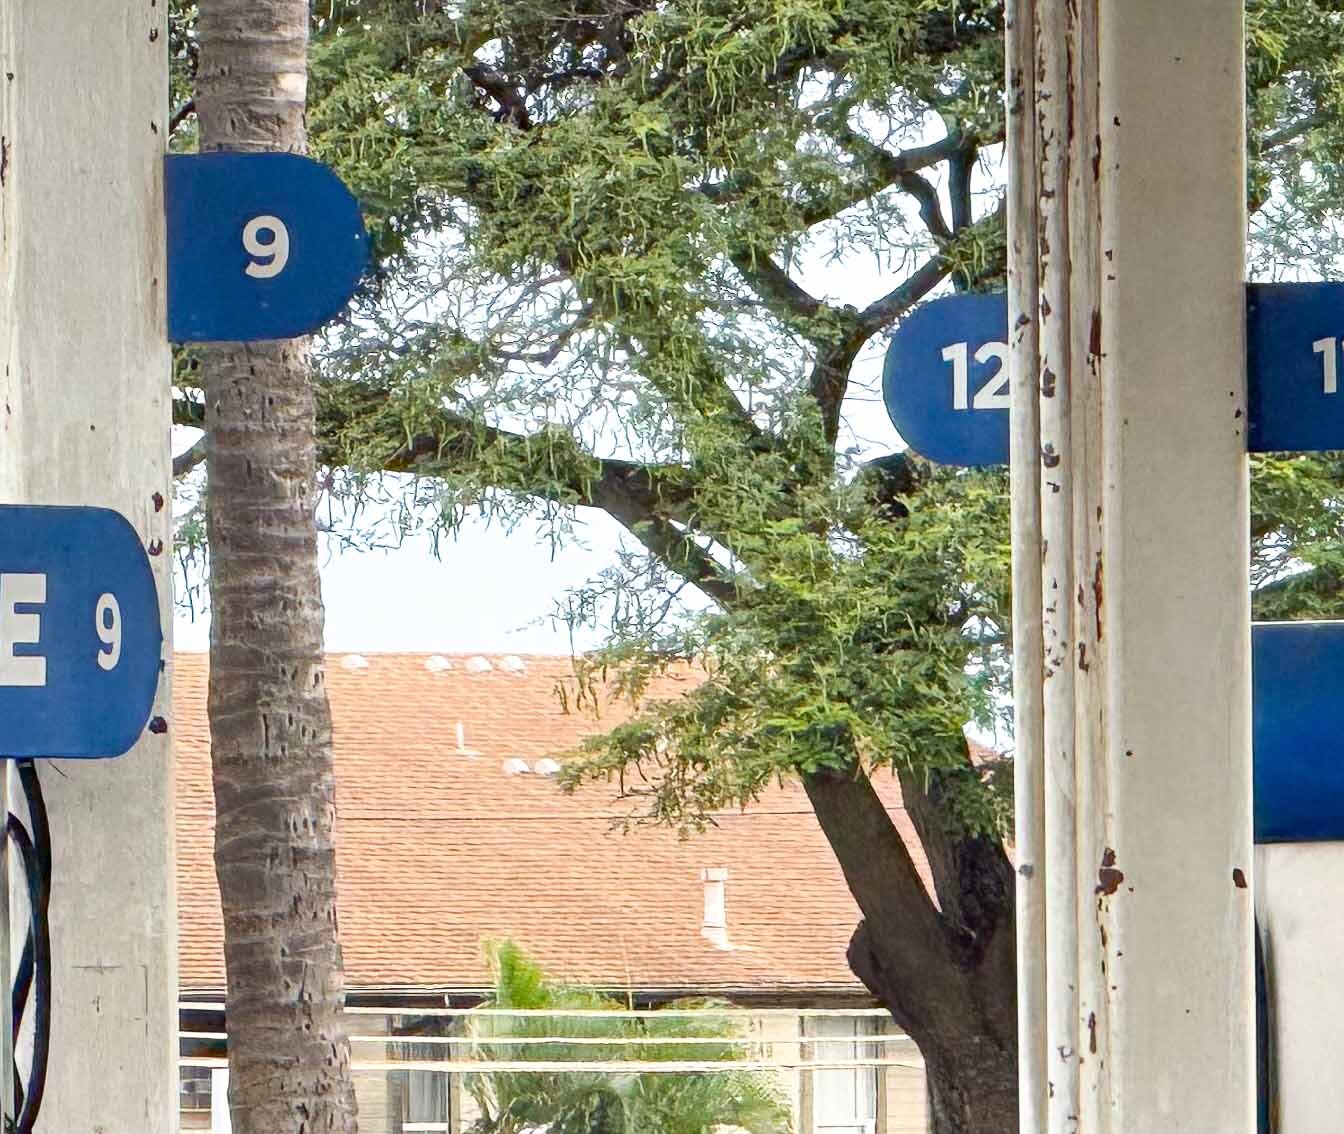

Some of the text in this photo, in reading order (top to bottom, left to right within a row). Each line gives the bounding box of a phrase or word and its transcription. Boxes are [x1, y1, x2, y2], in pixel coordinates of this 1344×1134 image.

[241, 215, 291, 280] 9
[940, 340, 1009, 410] 12
[95, 592, 122, 671] 9
